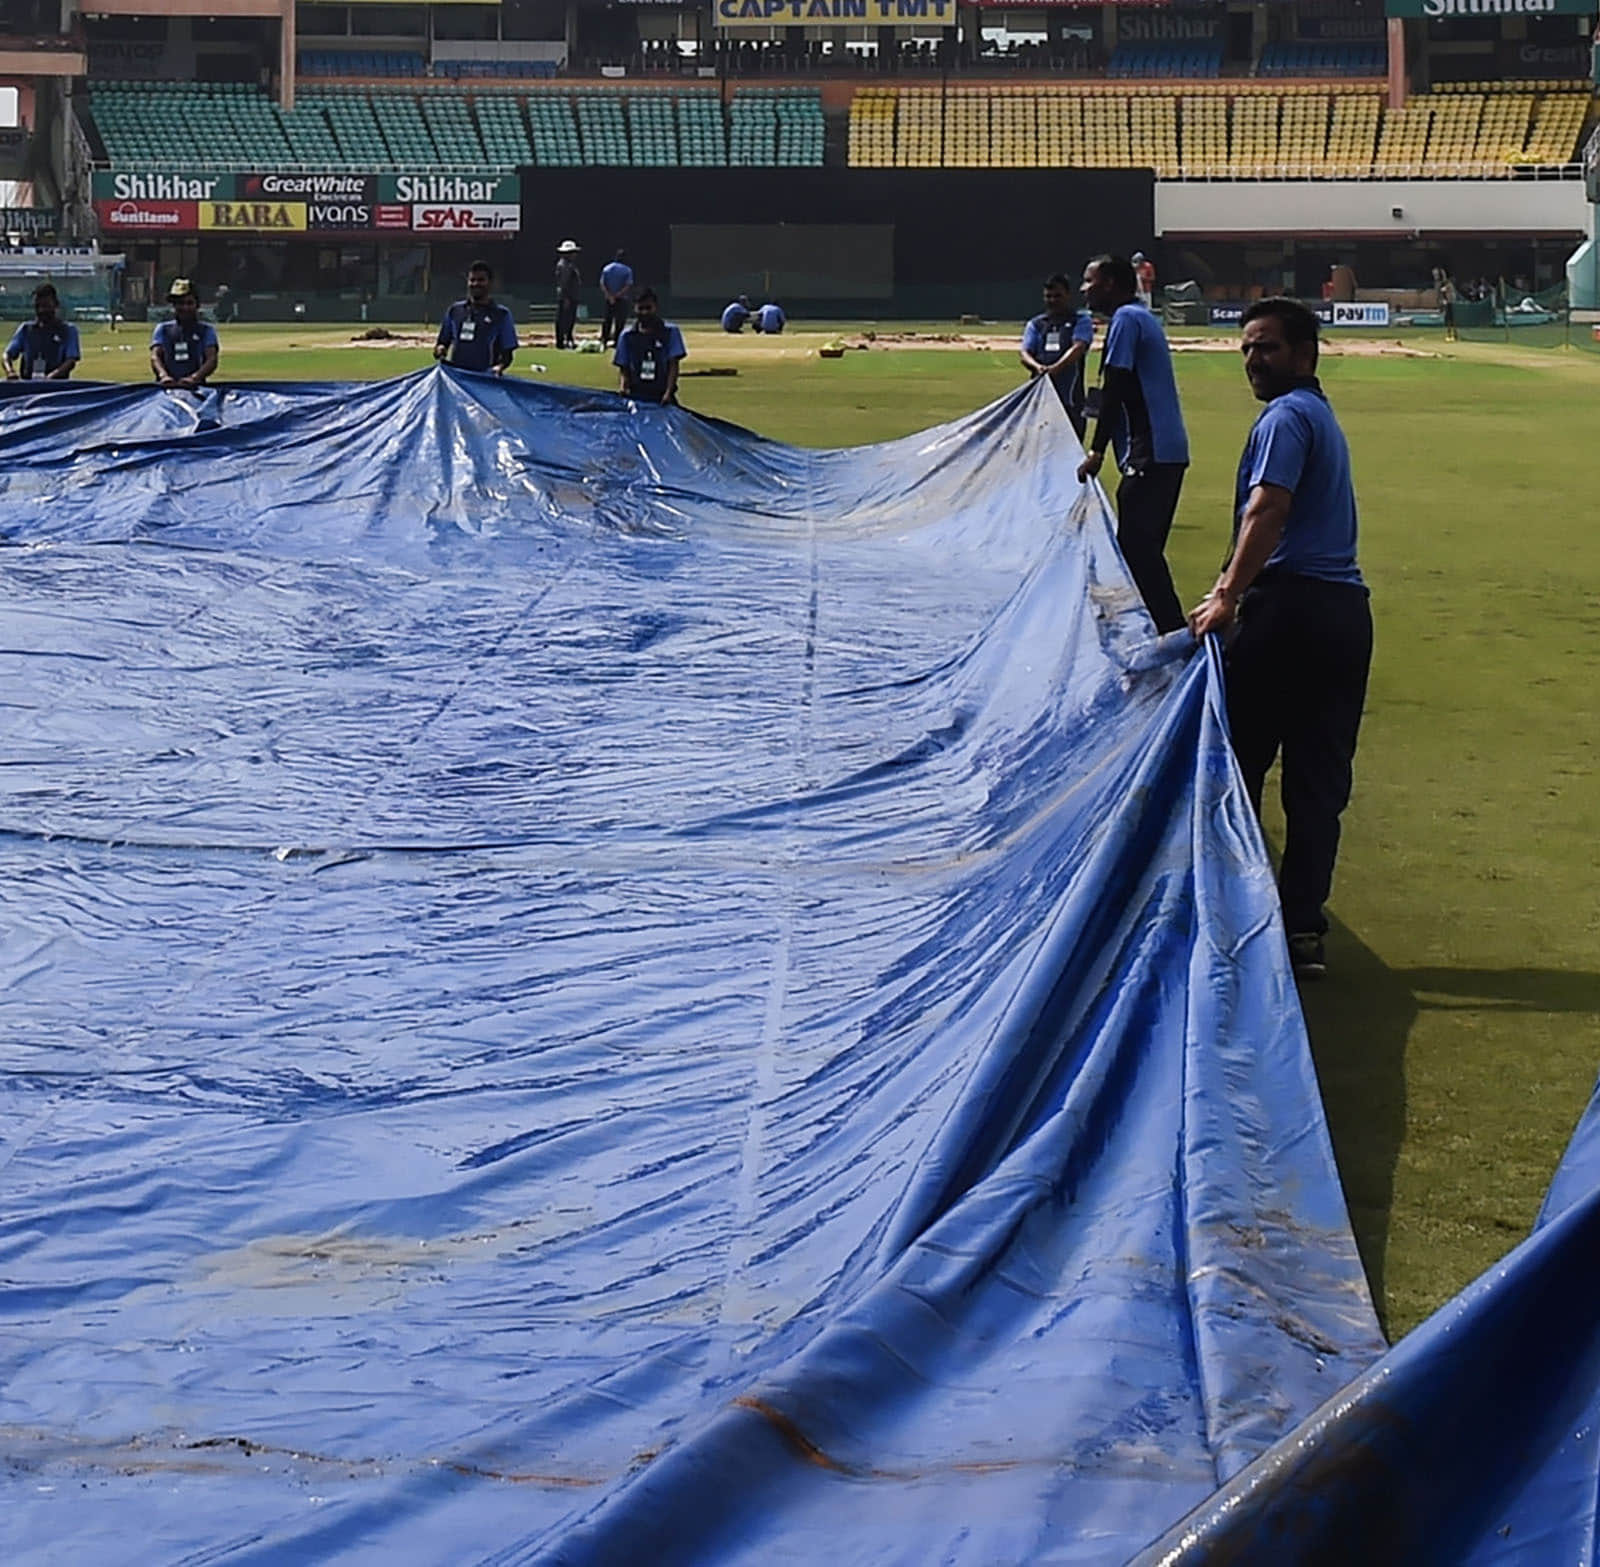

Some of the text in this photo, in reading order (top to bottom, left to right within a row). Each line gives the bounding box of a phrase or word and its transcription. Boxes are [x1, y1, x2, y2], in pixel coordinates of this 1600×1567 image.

[114, 174, 217, 200] Shikhar
[263, 175, 365, 194] GreatWhite
[396, 176, 498, 202] Shikhar
[211, 204, 294, 227] BABA
[1212, 308, 1243, 319] Scan
